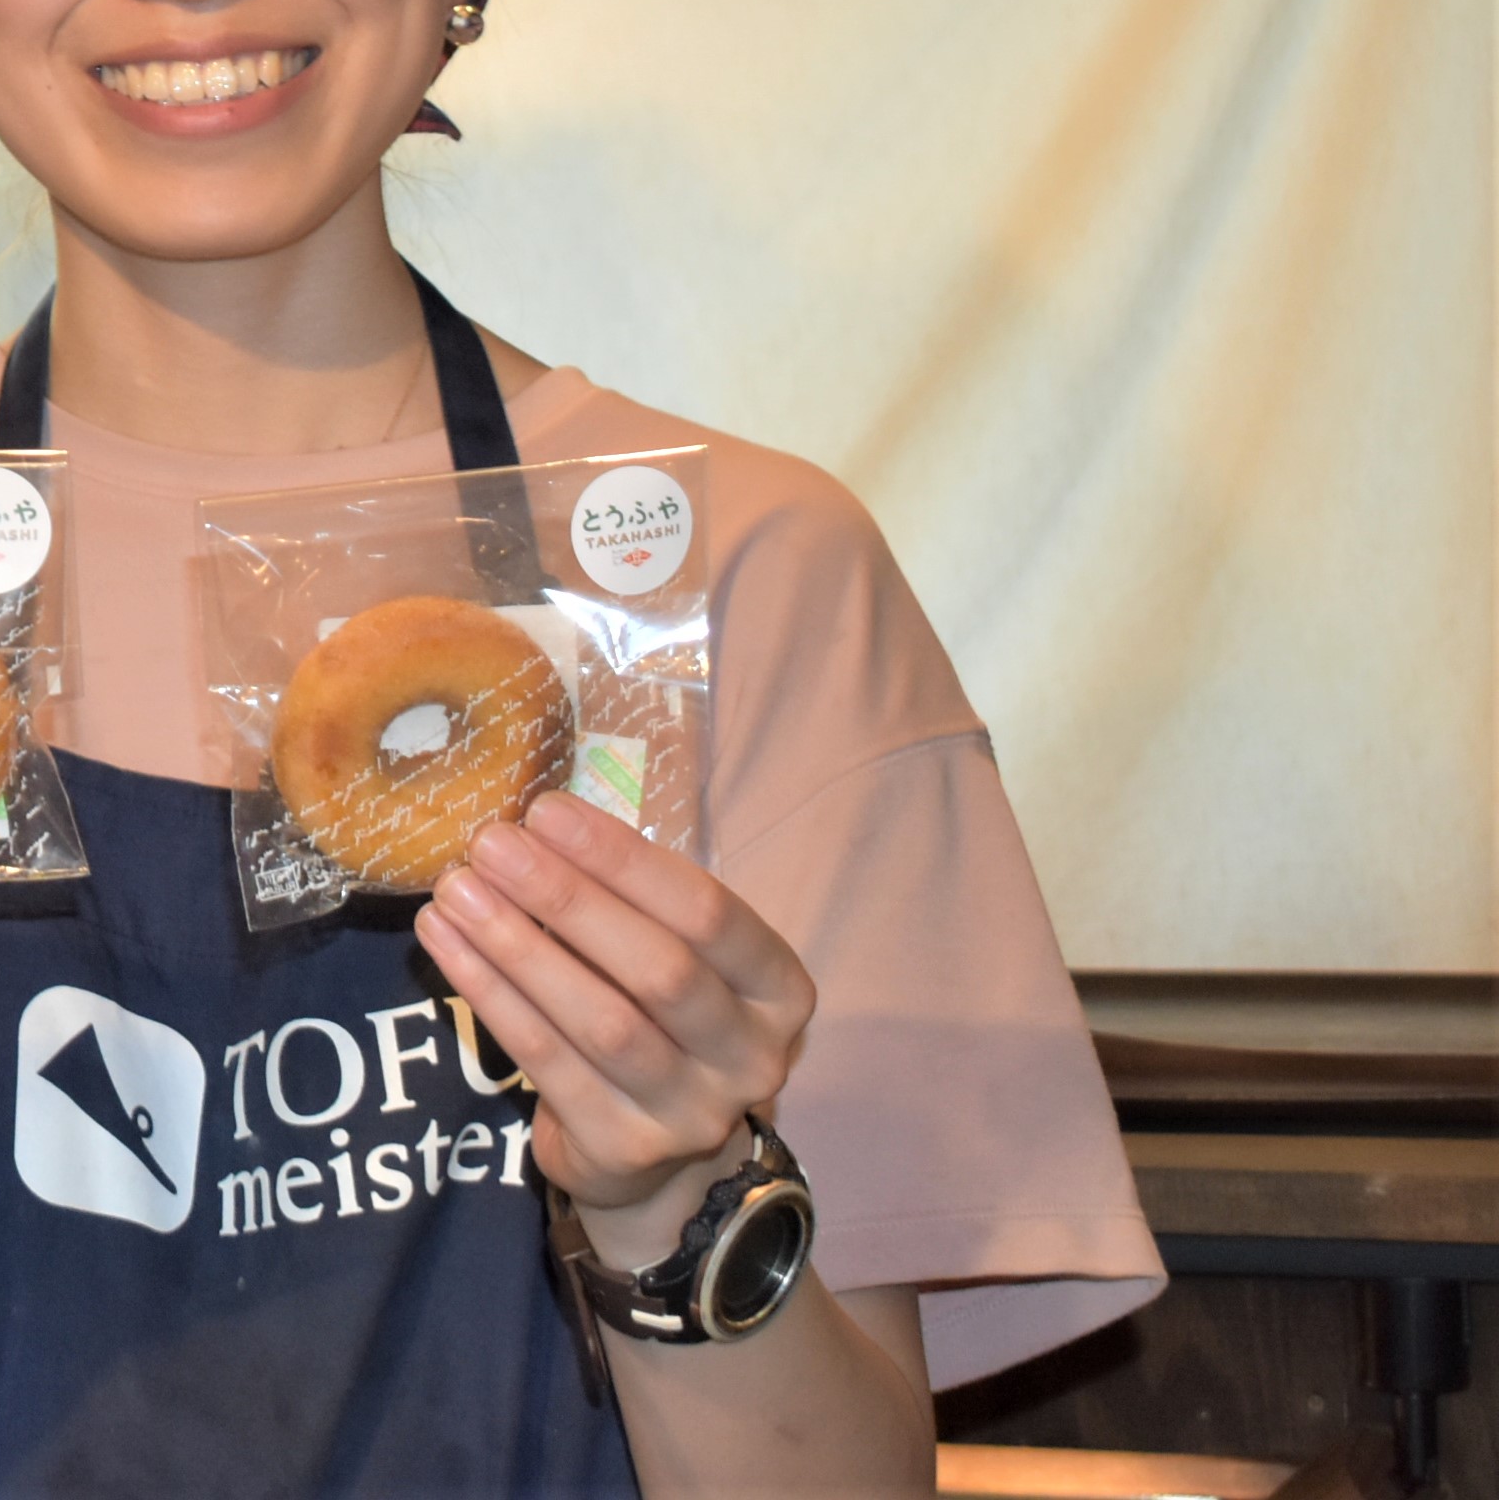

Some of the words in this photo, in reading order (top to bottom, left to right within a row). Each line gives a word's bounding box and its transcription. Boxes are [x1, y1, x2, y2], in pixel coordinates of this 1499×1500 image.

[582, 496, 680, 532] とうふや
[585, 524, 681, 549] TAKAHASHI
[218, 1117, 534, 1237] meister
